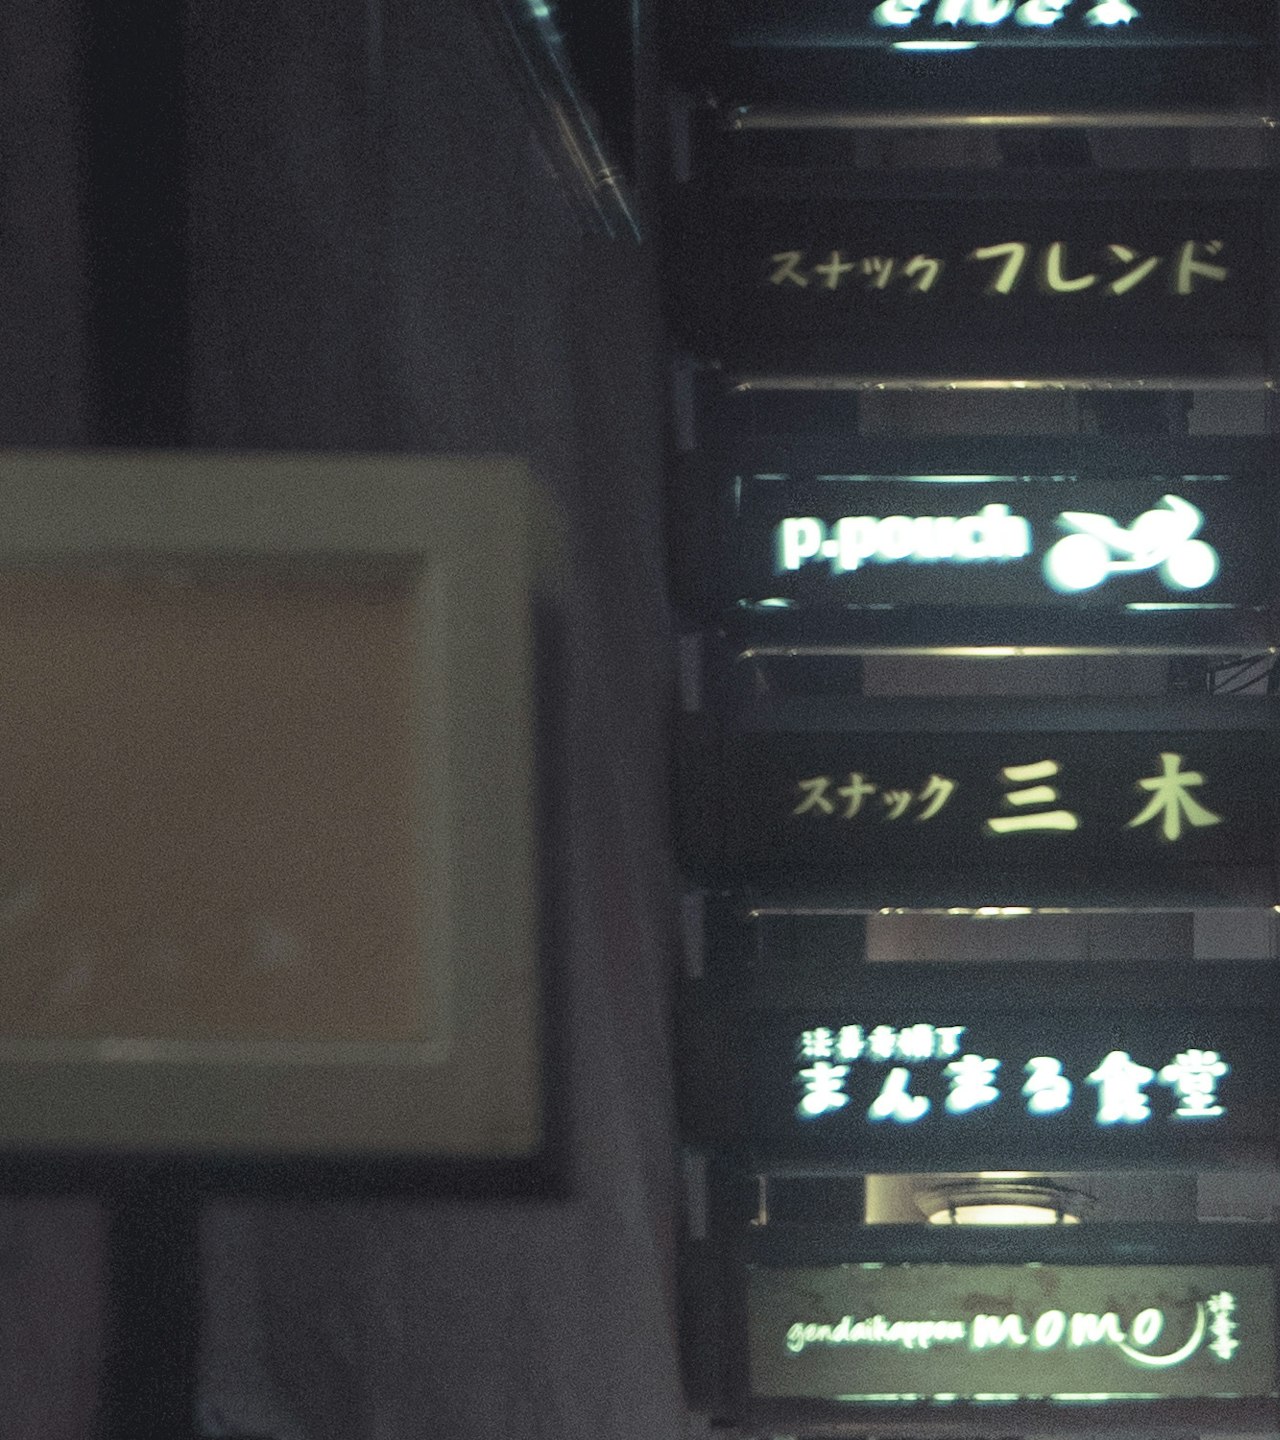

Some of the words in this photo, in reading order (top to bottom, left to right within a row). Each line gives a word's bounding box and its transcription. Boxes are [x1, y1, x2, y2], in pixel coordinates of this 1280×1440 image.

[768, 248, 943, 294] スナック
[970, 238, 1226, 295] フレンド
[793, 773, 957, 820] スナック
[986, 753, 1223, 840] 三木
[799, 1048, 1230, 1123] まんまる食堂
[971, 1308, 1165, 1348] momo
